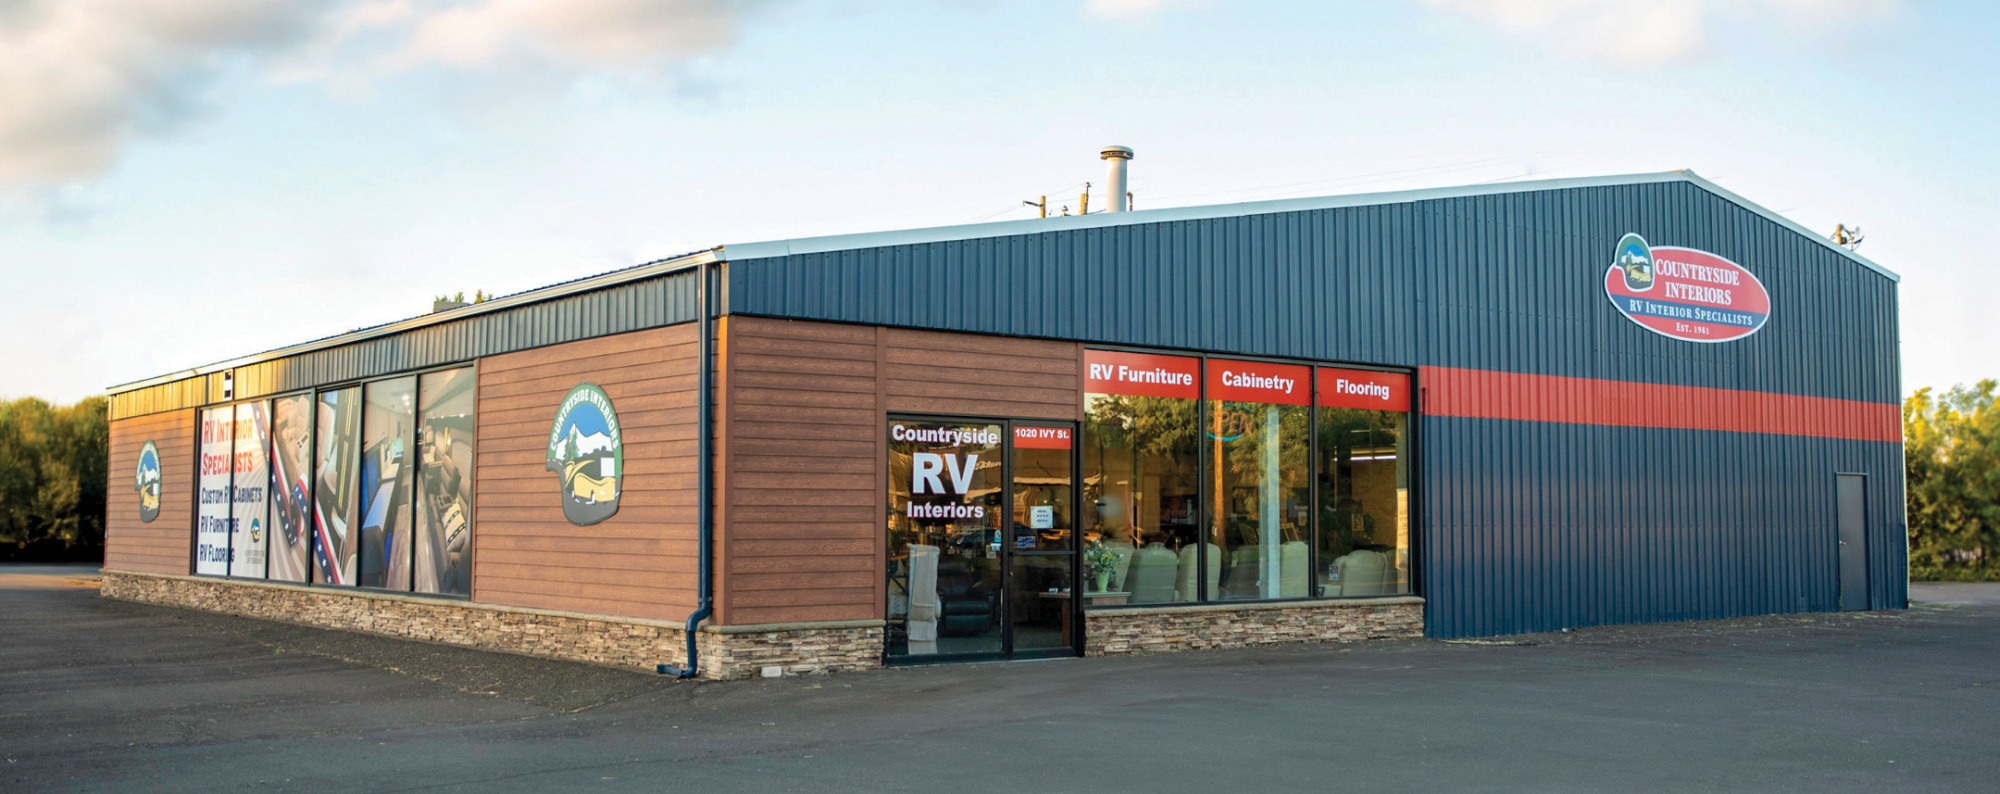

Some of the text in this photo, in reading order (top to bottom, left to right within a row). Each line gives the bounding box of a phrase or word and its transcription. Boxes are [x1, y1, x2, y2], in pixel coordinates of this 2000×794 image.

[1655, 258, 1740, 286] COUNTRYSIDE
[1665, 281, 1732, 306] INTERIORS
[1629, 299, 1753, 326] RV INTERIOR SPECIALISTS
[1694, 325, 1710, 335] 1981
[1089, 363, 1193, 386] RV Furniture
[1221, 370, 1295, 394] Cabinetry
[1336, 379, 1390, 400] Flooring
[551, 389, 619, 451] COUNTRYSIDE INTERIORS
[1206, 410, 1254, 434] OPEN
[204, 420, 215, 444] RV
[892, 424, 998, 447] Countryside
[1015, 428, 1070, 439] 1020 IVY St.
[203, 451, 253, 476] SPECIAISTS
[912, 452, 979, 495] RV
[201, 485, 262, 505] CUSTOM R CABINETS
[907, 501, 984, 519] Interiors
[201, 515, 240, 533] RV FURNITRE
[200, 543, 208, 562] RV
[208, 543, 235, 563] FLOORIG
